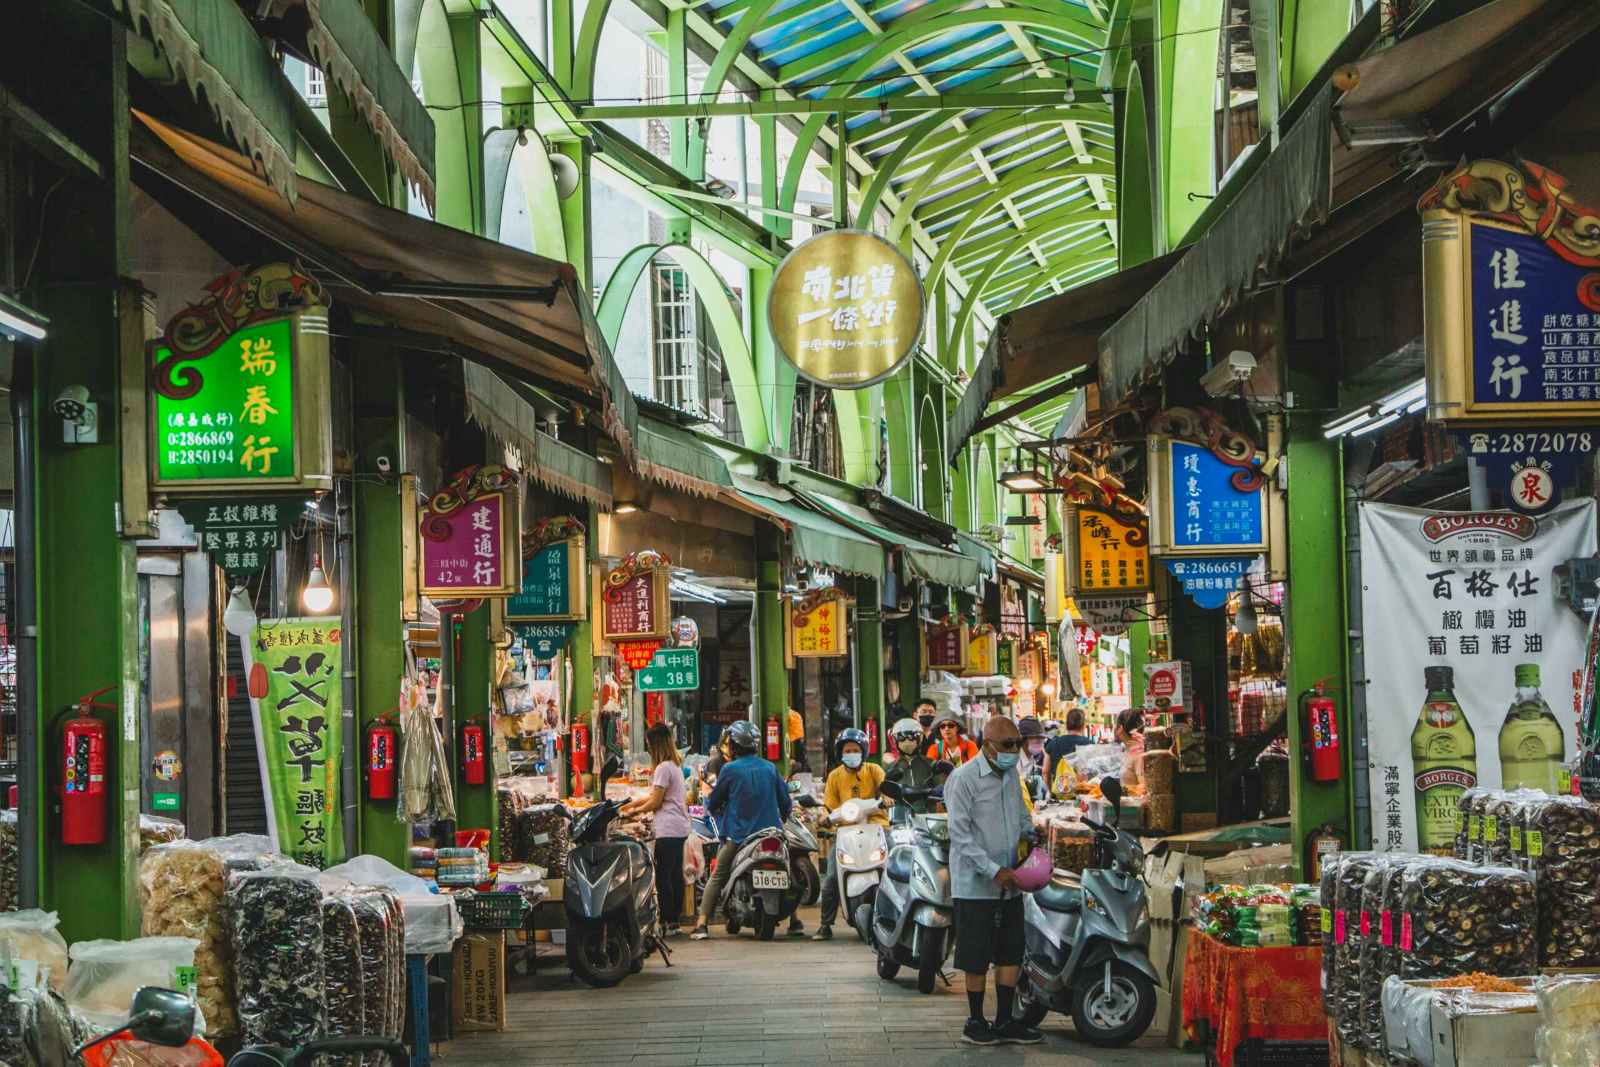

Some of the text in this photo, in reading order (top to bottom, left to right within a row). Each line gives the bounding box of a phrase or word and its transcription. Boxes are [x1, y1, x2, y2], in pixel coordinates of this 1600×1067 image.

[1488, 247, 1529, 400] 佳進行
[239, 337, 279, 474] 瑞春行
[1520, 472, 1547, 504] 泉
[206, 531, 277, 549] 堅果系列
[1429, 548, 1534, 563] 世界領導品牌
[1426, 569, 1540, 600] 百格仕
[1442, 608, 1526, 630] 橄欖油
[525, 625, 566, 638] 2865854
[1428, 633, 1543, 656] 葡萄籽油
